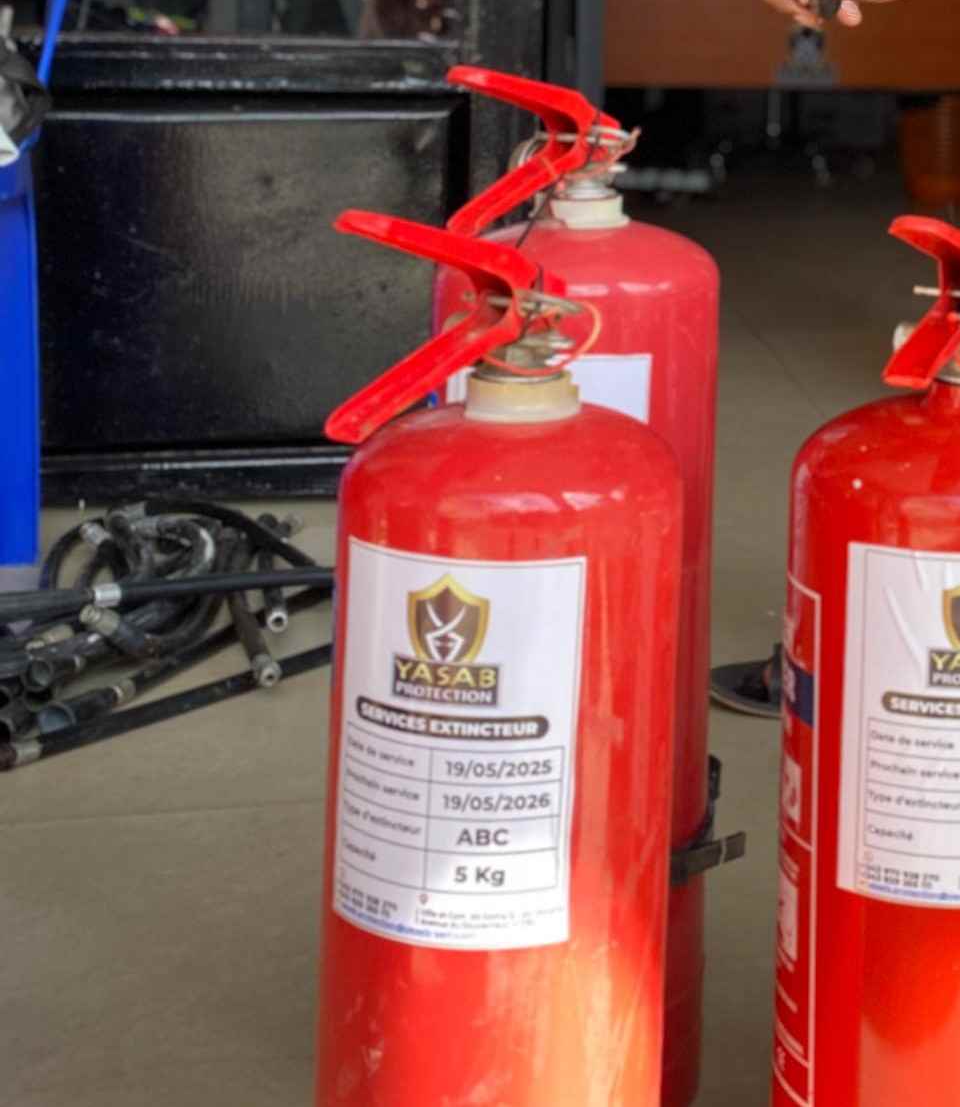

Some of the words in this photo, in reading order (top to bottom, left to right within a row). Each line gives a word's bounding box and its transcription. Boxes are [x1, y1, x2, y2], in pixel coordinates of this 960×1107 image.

[396, 660, 497, 688] YASAB
[396, 682, 492, 703] PROTECTION
[360, 702, 427, 731] SERVICES
[430, 720, 540, 738] EXTINCTEUR
[445, 759, 553, 779] 19/05/2025
[442, 792, 551, 813] 19/05/2026
[456, 827, 510, 846] ABC
[454, 865, 468, 884] 5
[475, 866, 506, 888] Kg
